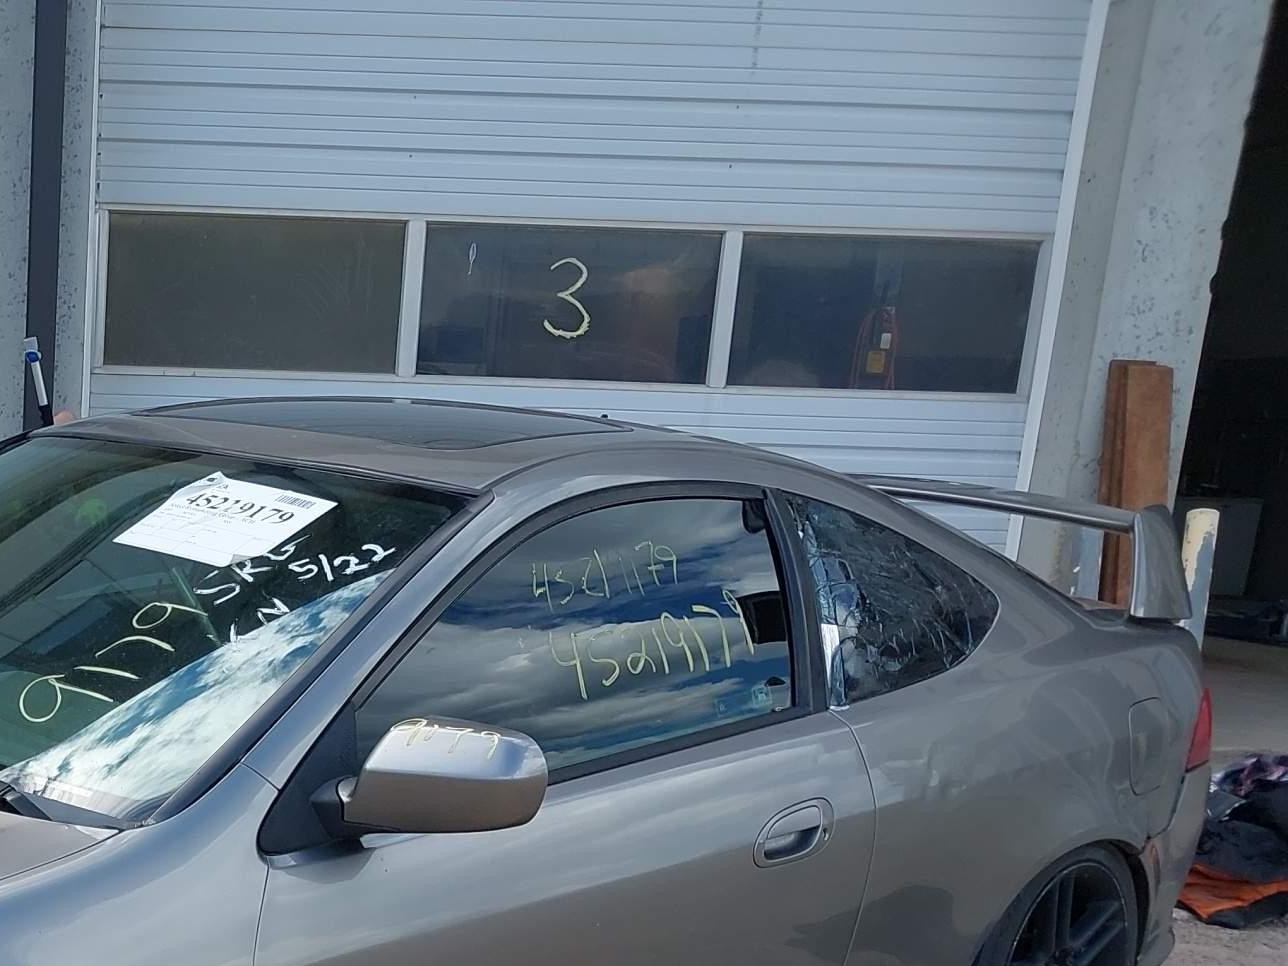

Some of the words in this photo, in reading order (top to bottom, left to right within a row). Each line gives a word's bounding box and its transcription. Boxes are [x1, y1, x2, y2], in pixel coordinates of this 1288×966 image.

[543, 256, 592, 340] 3
[186, 492, 296, 525] 45219179
[18, 601, 210, 724] 9179
[548, 588, 755, 701] 45219179
